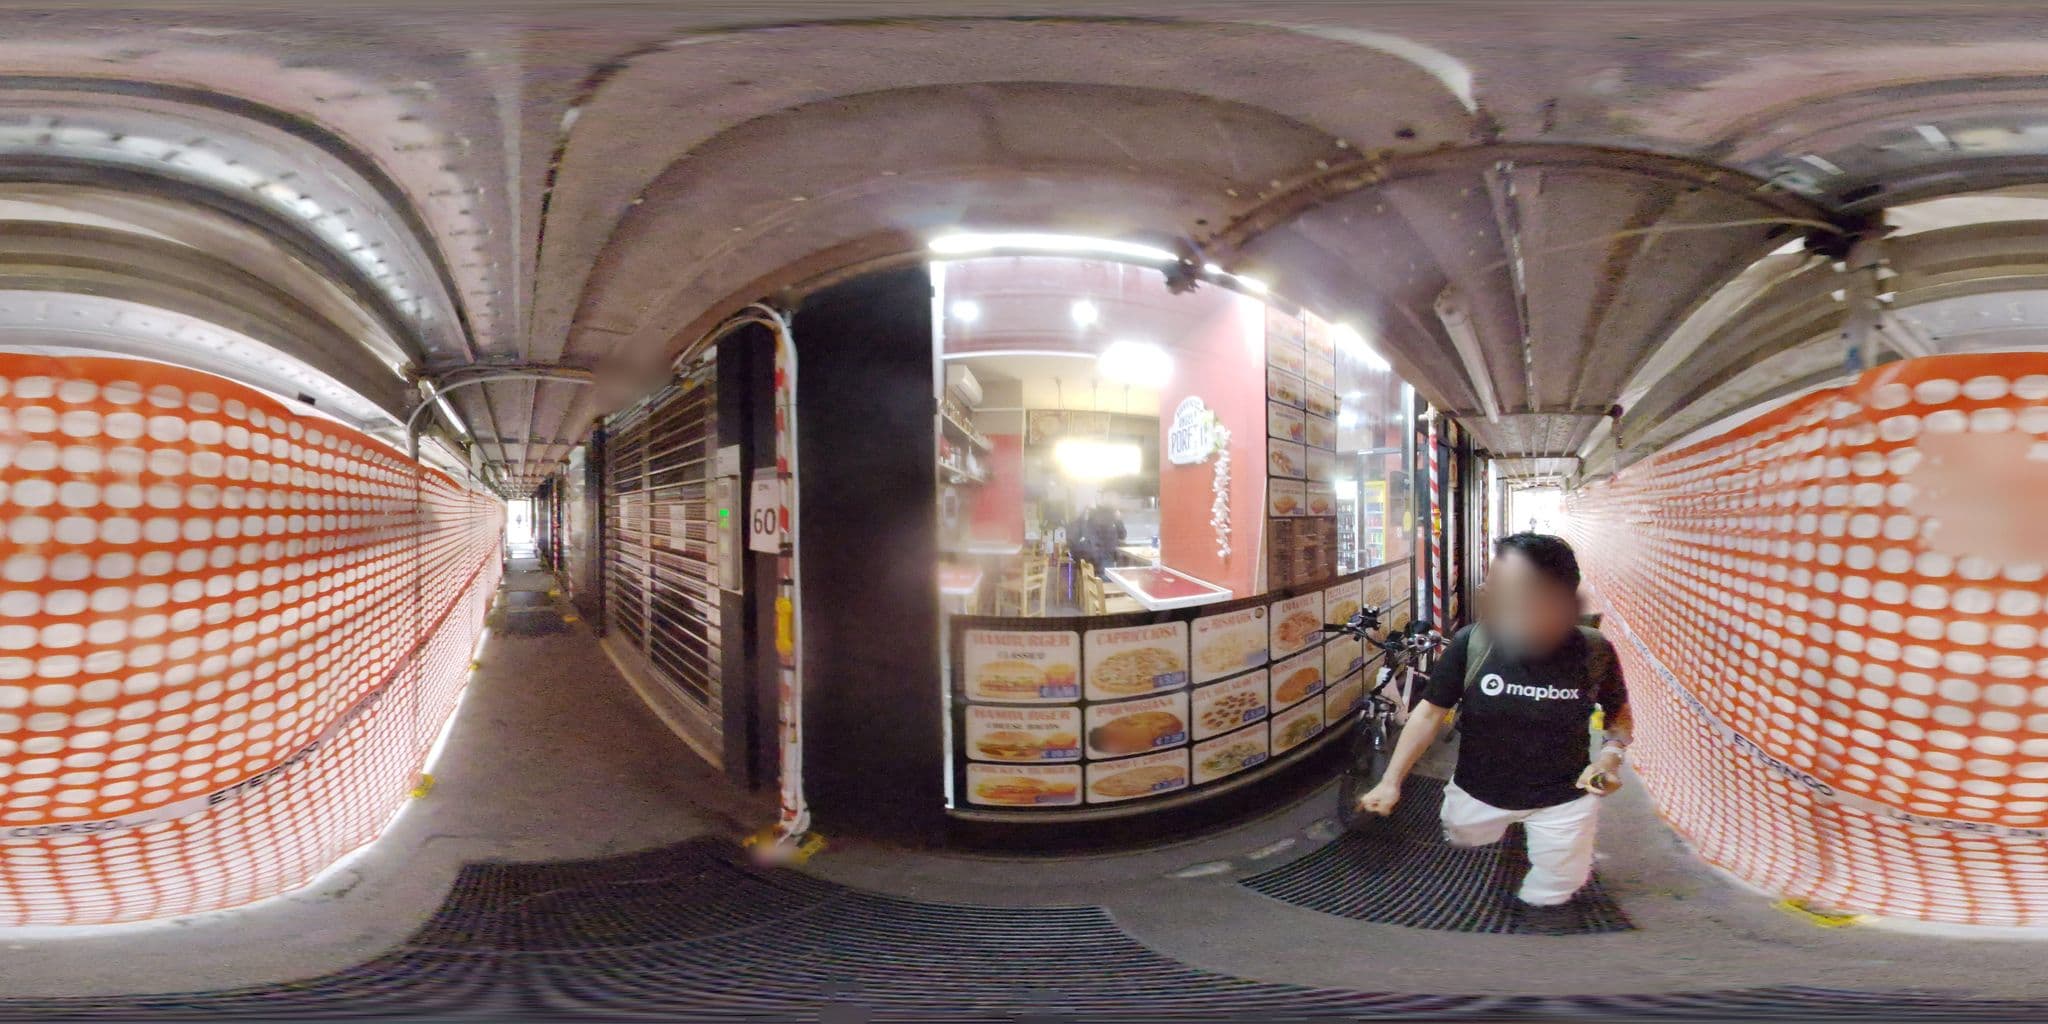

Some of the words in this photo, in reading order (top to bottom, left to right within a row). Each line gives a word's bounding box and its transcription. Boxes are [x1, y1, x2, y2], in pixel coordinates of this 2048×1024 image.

[753, 507, 776, 535] 60
[973, 634, 1070, 647] HAMBURGER
[1506, 682, 1580, 701] mapbox
[975, 708, 1072, 720] HAMBURGER
